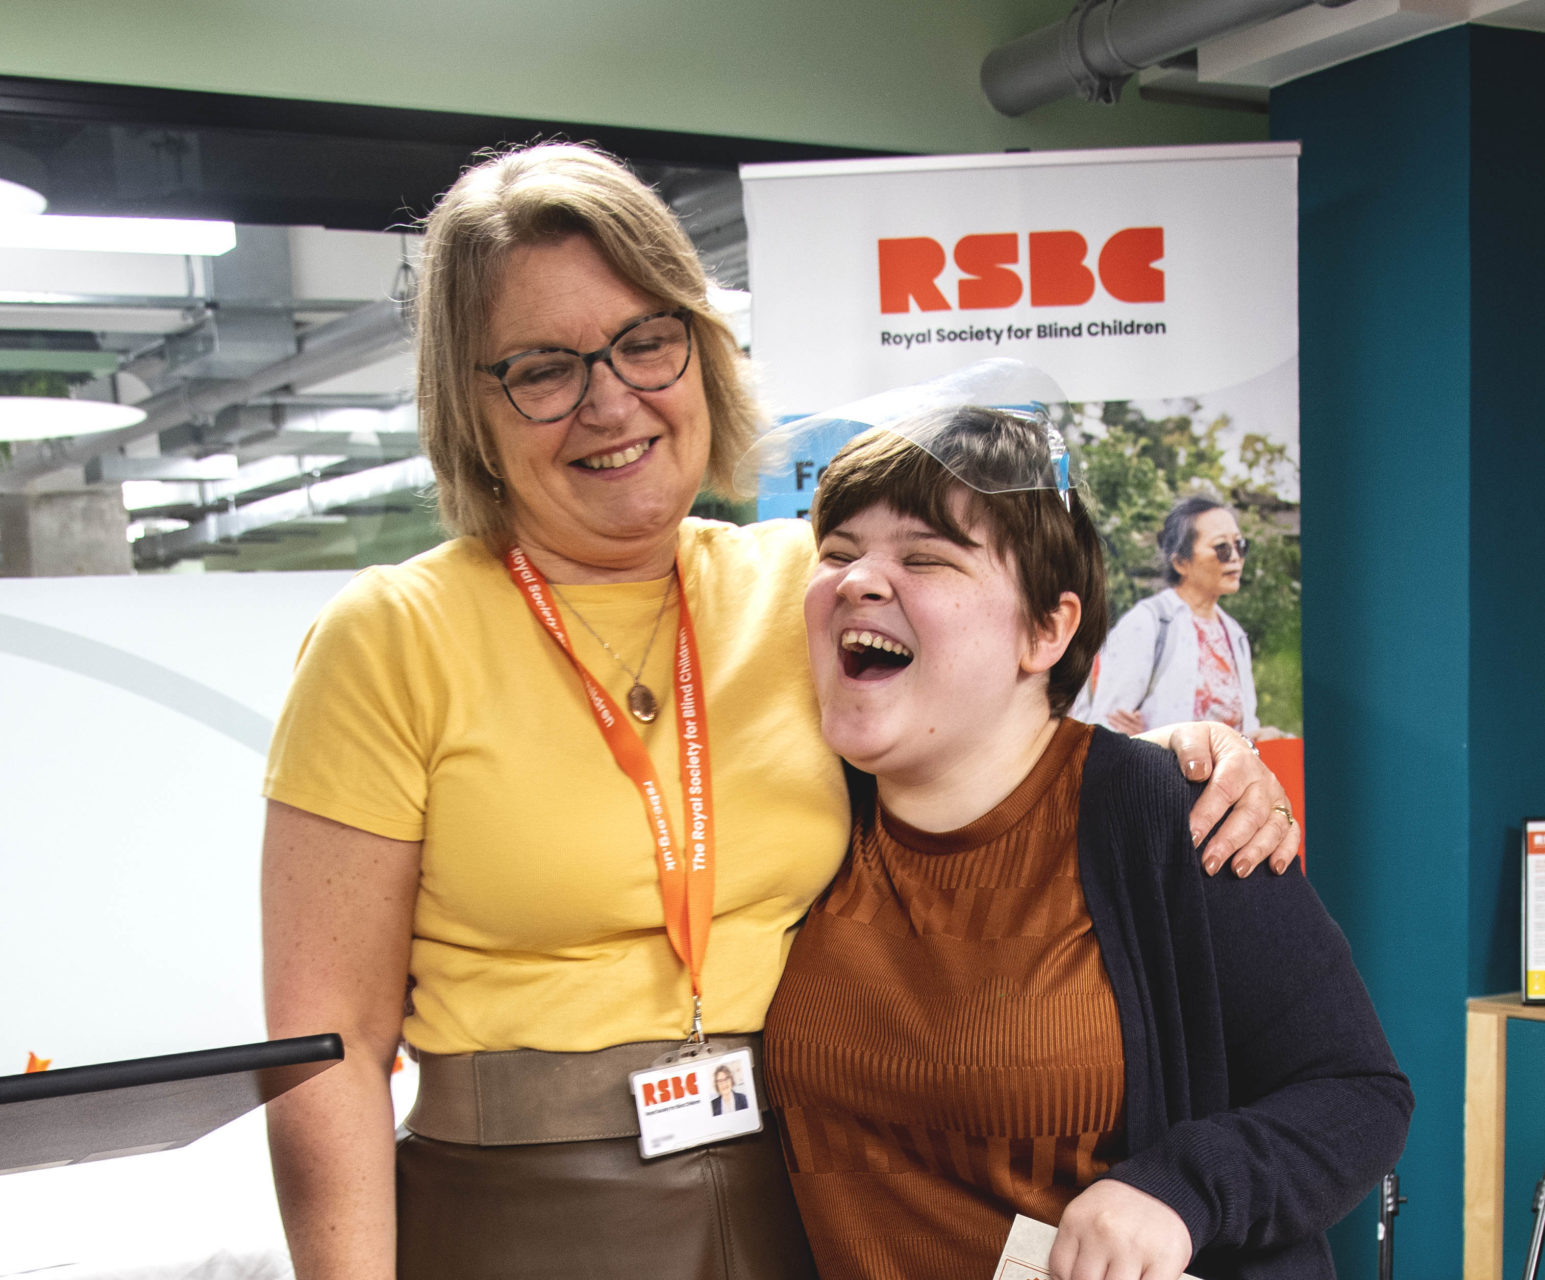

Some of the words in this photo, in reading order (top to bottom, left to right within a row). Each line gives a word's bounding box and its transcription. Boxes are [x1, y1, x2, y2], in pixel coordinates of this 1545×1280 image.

[878, 227, 1165, 314] RSBC
[881, 329, 931, 349] Royal
[936, 325, 1003, 345] Society
[1007, 323, 1033, 339] for
[1037, 321, 1083, 339] Blind
[1087, 318, 1166, 336] Children
[528, 583, 558, 630] Society
[678, 626, 692, 683] Children
[679, 684, 696, 718] Blind
[683, 720, 698, 740] for
[685, 741, 703, 795] Society
[689, 797, 708, 840] Royal
[692, 843, 706, 872] The
[642, 1072, 699, 1107] RSBC
